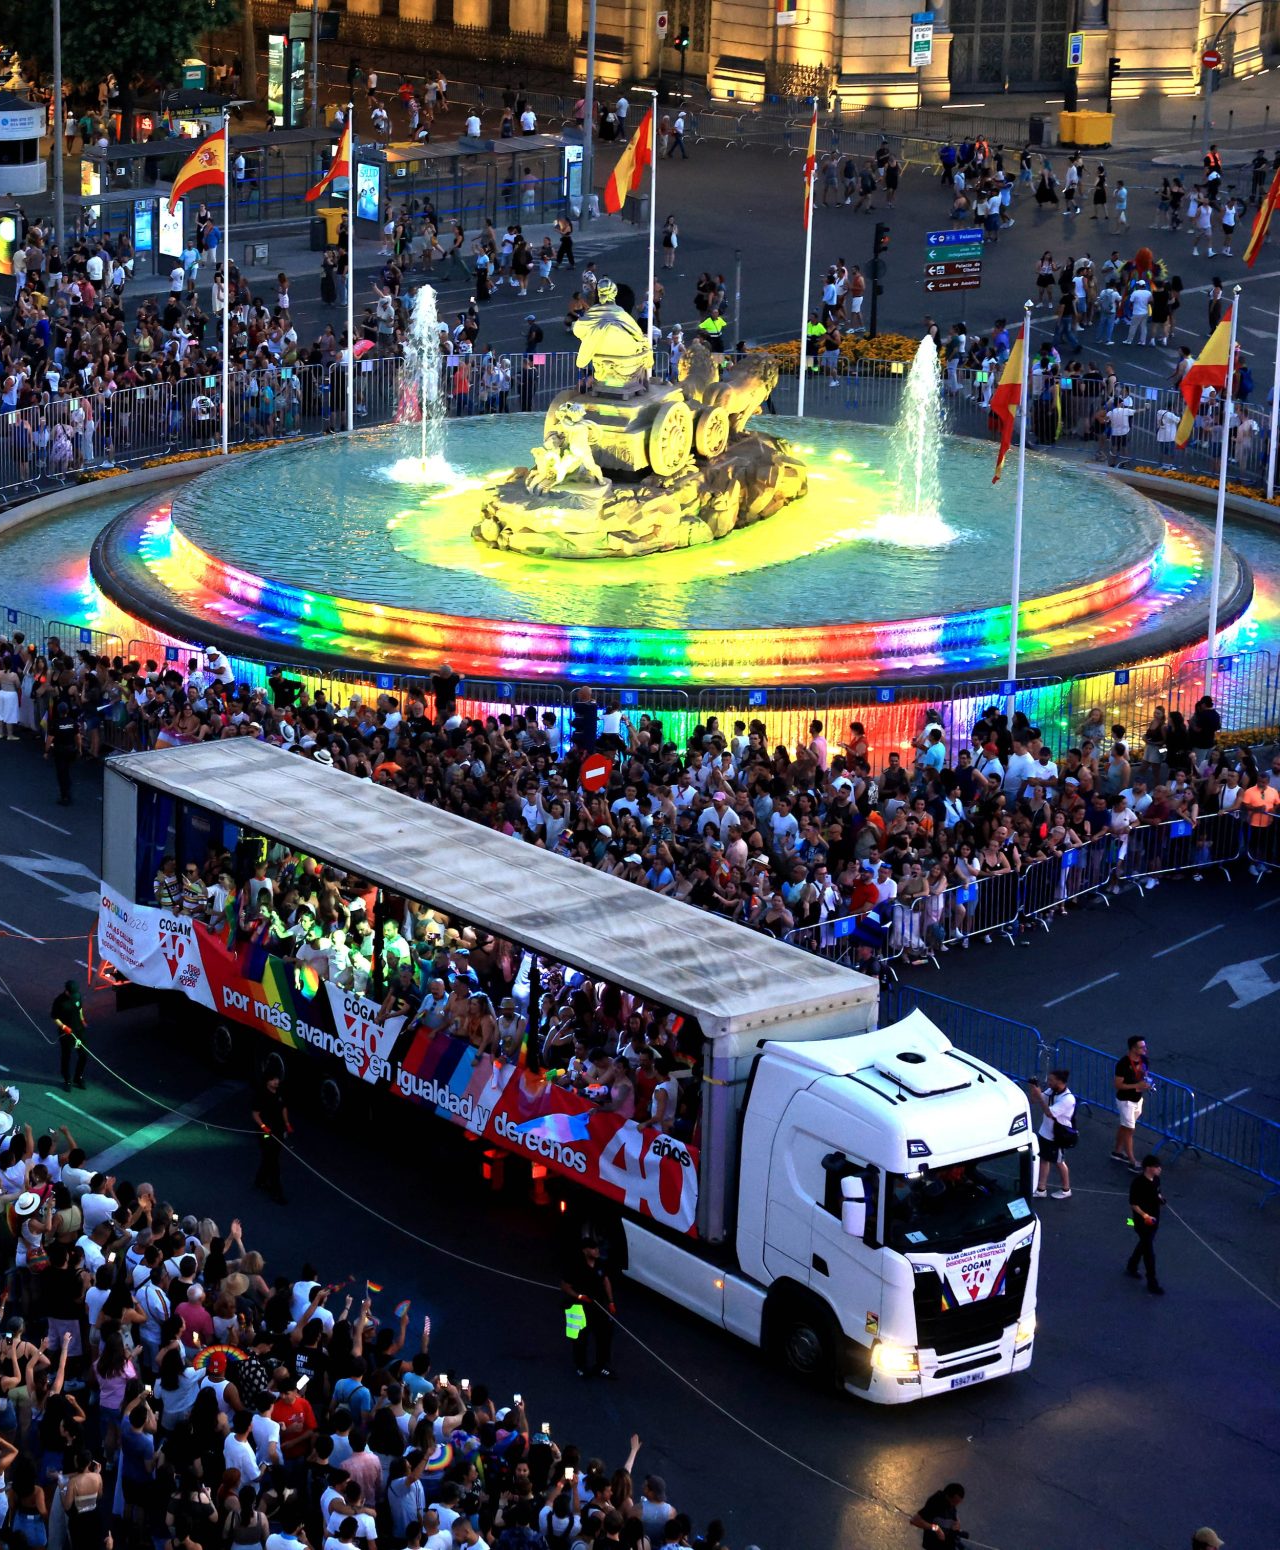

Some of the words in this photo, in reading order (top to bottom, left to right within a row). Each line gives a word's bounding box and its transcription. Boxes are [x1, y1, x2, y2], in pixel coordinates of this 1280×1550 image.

[102, 896, 128, 923] ORGULLO
[160, 934, 188, 964] 40
[223, 985, 250, 1012] por
[254, 1002, 292, 1032] más
[296, 1019, 364, 1067] avances
[370, 1054, 392, 1081] en
[396, 1061, 474, 1120] igualdad
[475, 1104, 490, 1136] y
[494, 1112, 587, 1173] derechos
[599, 1119, 699, 1234] 40
[652, 1138, 691, 1168] años
[961, 1259, 991, 1273] COGAM
[977, 1248, 1006, 1259] RESISTENCIA
